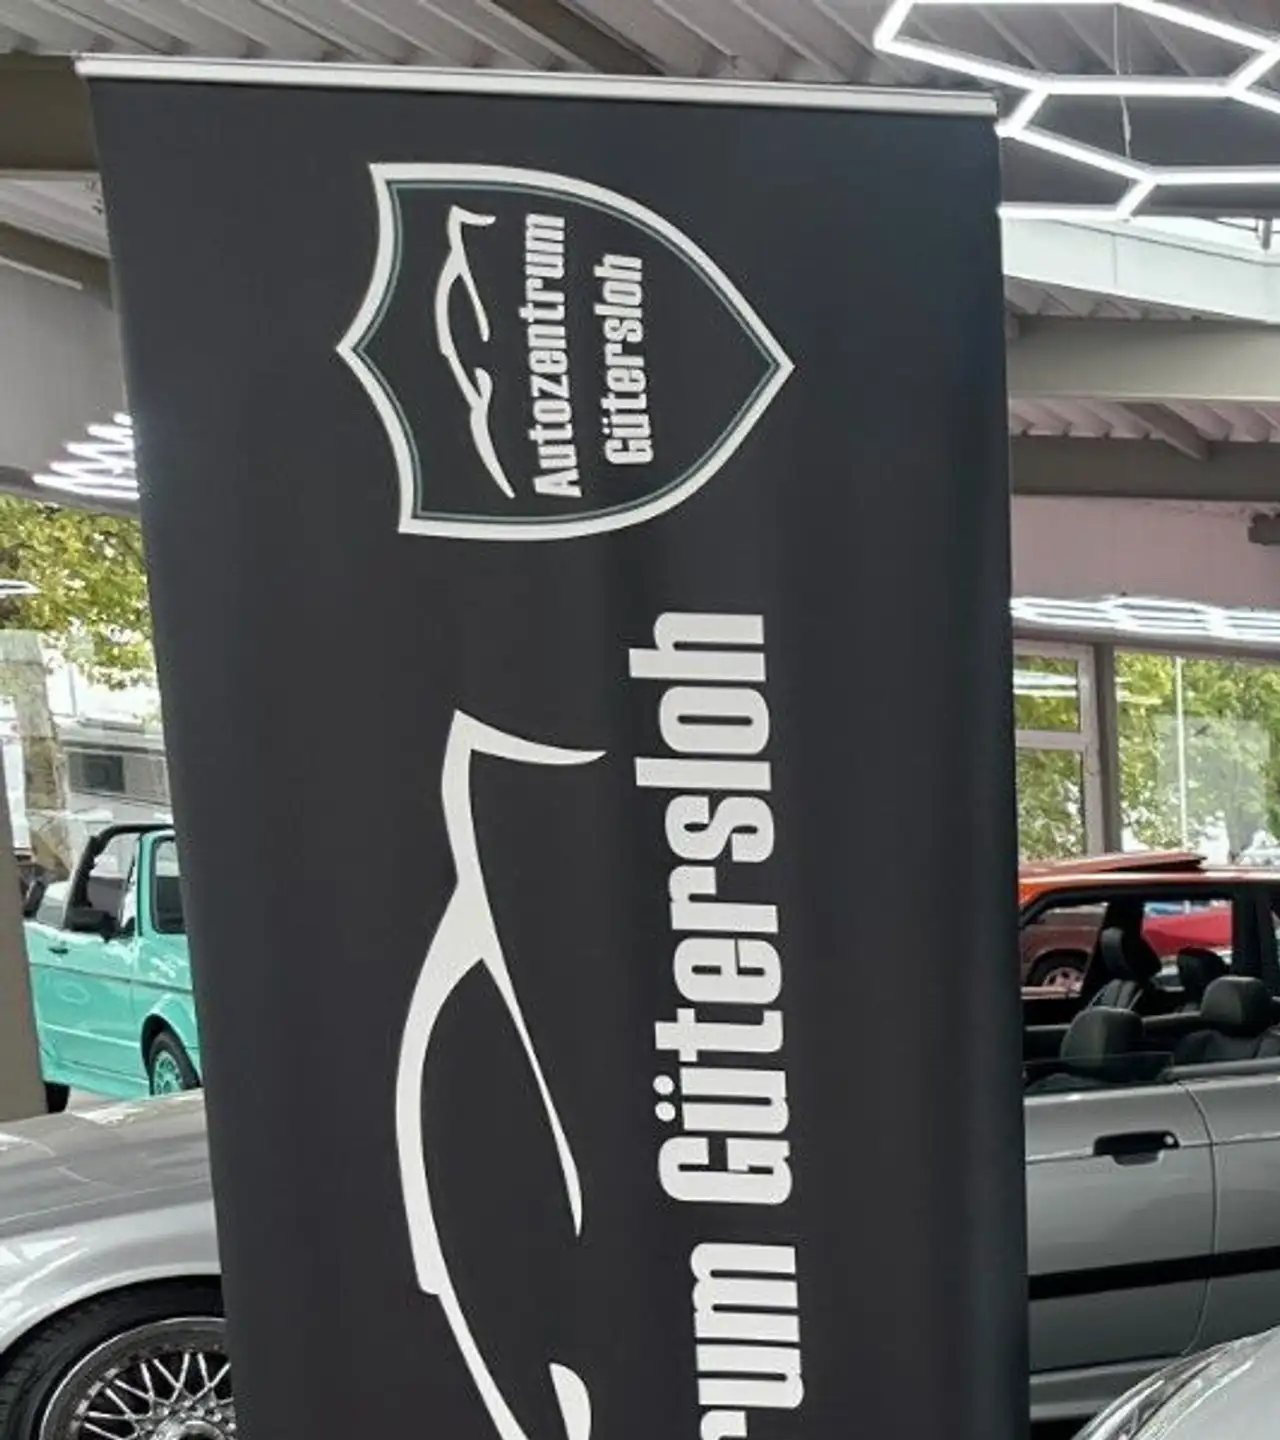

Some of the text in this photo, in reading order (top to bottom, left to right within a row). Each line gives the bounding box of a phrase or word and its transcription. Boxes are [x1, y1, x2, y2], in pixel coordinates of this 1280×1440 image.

[519, 213, 582, 498] Autozentrum
[593, 253, 654, 465] Gütersloh
[628, 611, 793, 1205] Gütersloh
